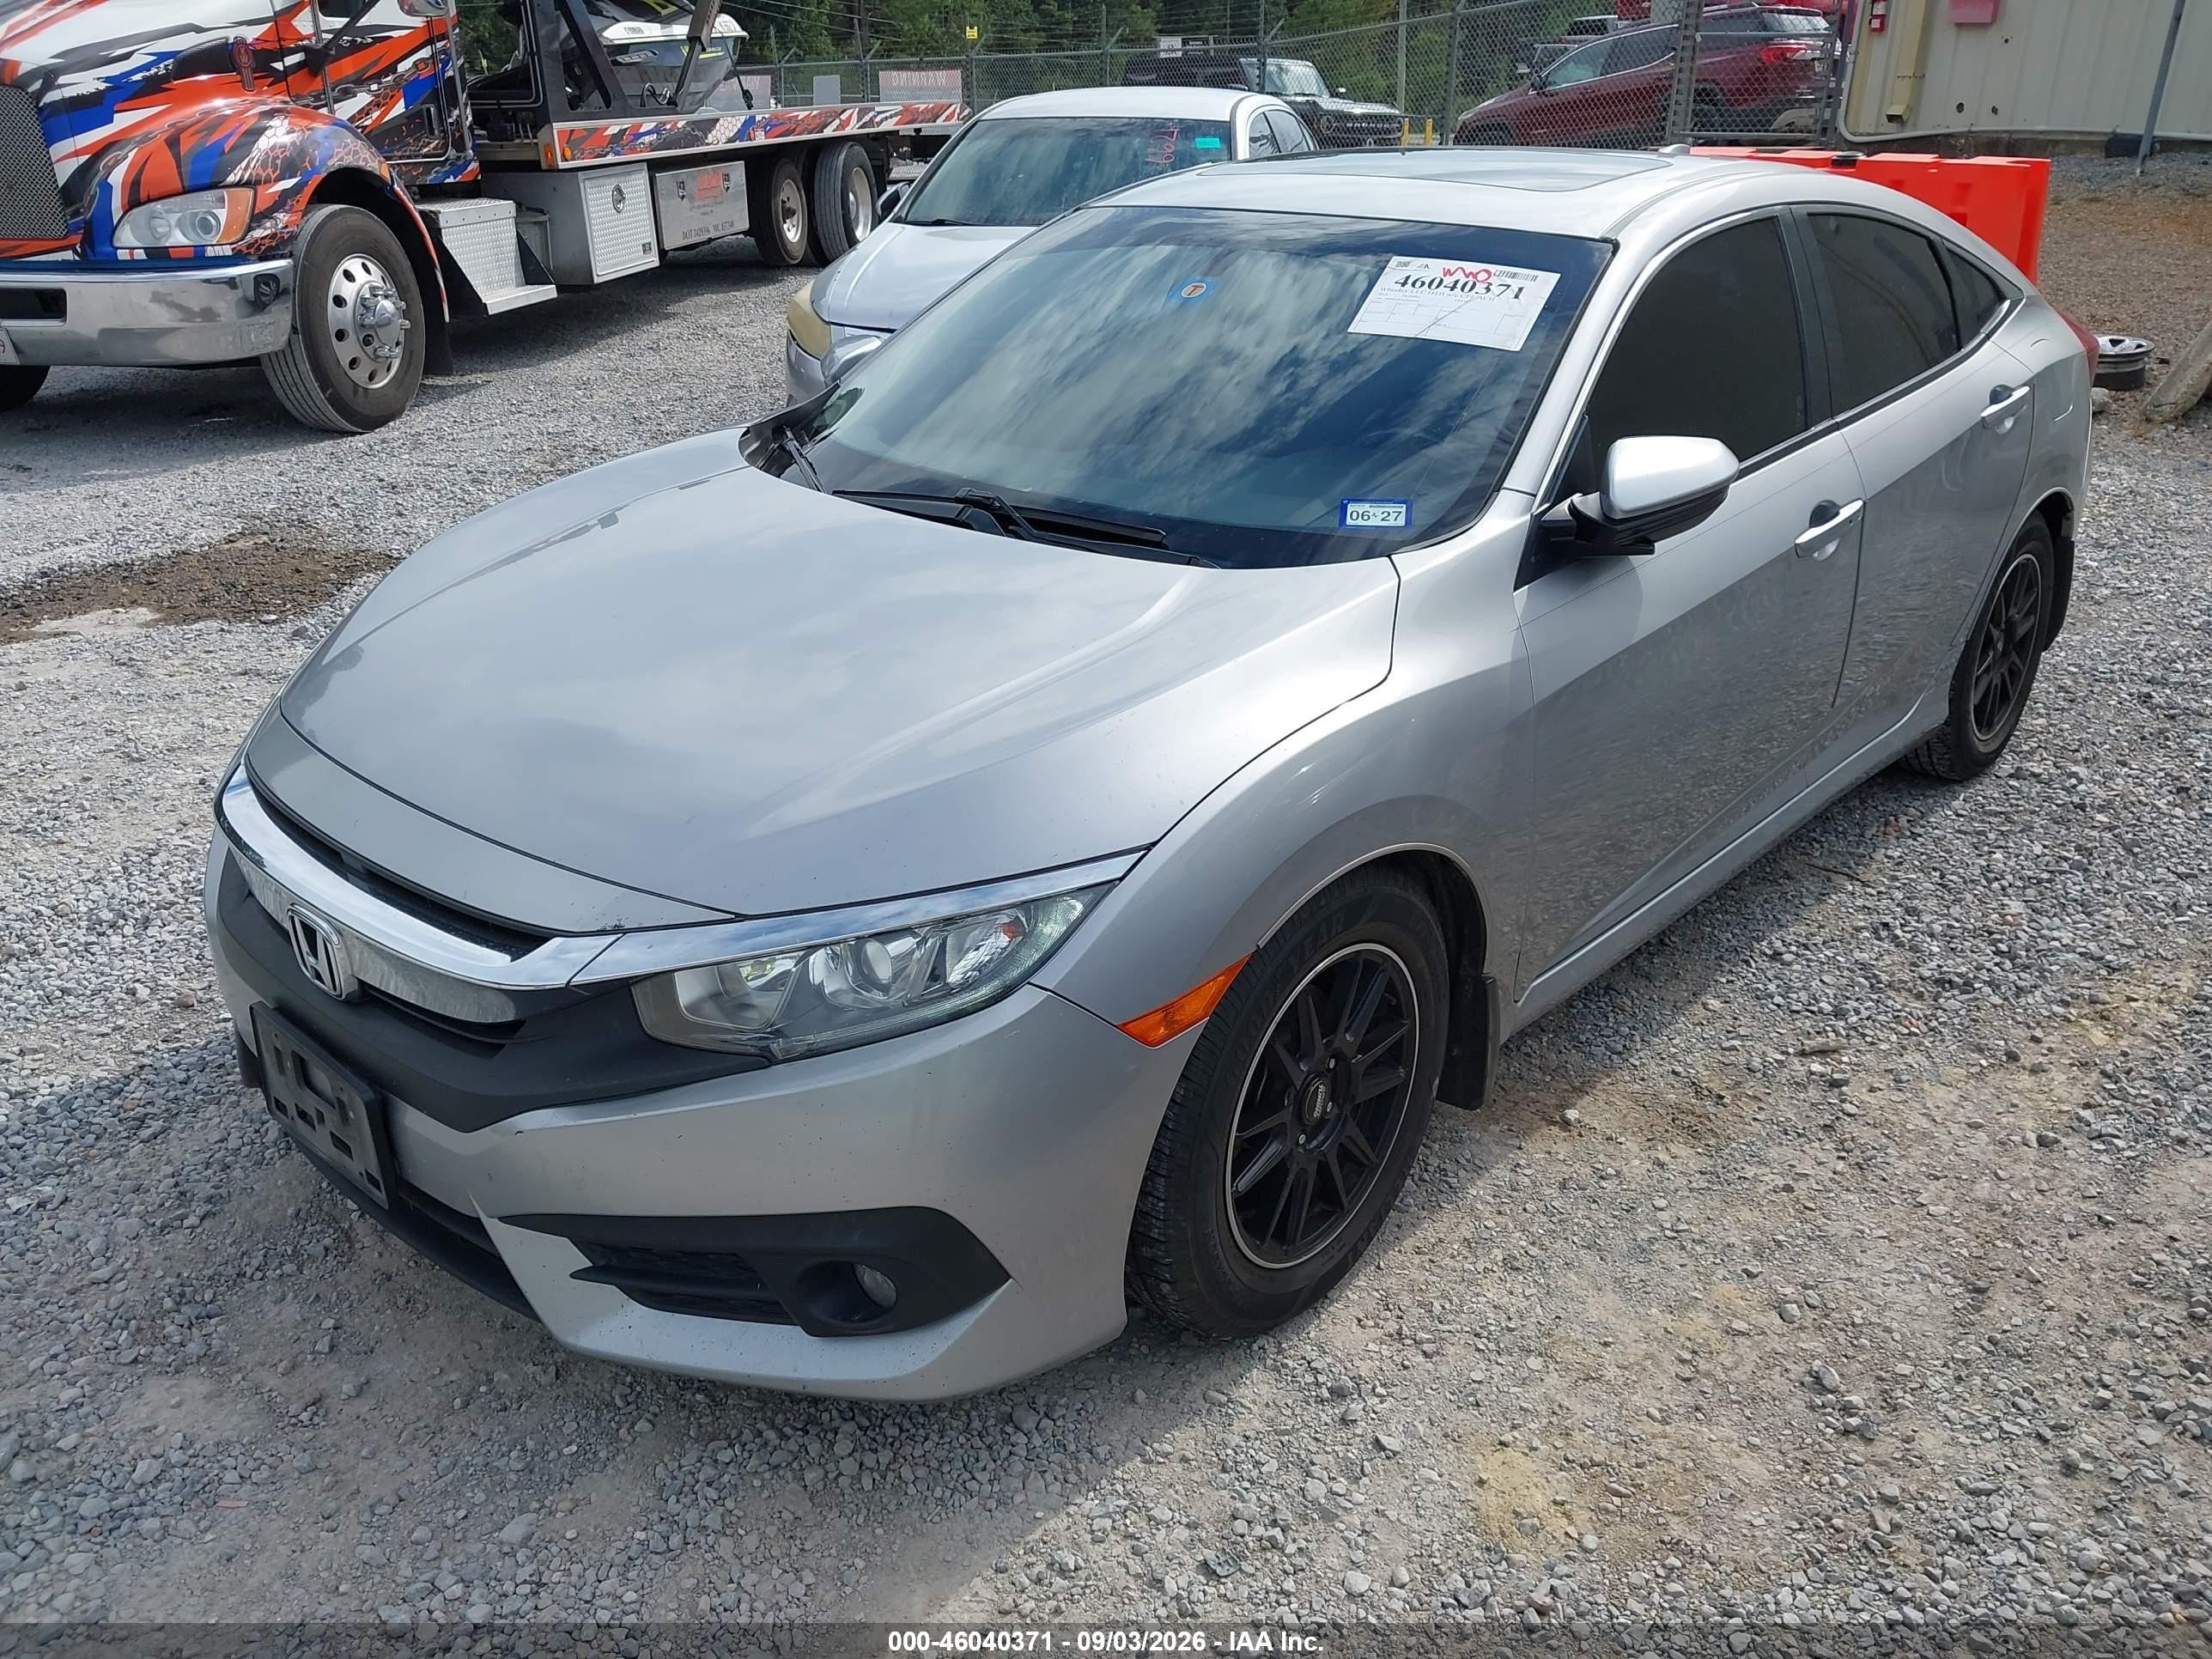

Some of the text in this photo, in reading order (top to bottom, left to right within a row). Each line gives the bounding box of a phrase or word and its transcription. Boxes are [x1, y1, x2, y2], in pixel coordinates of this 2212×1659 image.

[1394, 273, 1526, 301] 46040371
[1349, 510, 1403, 522] 06 27
